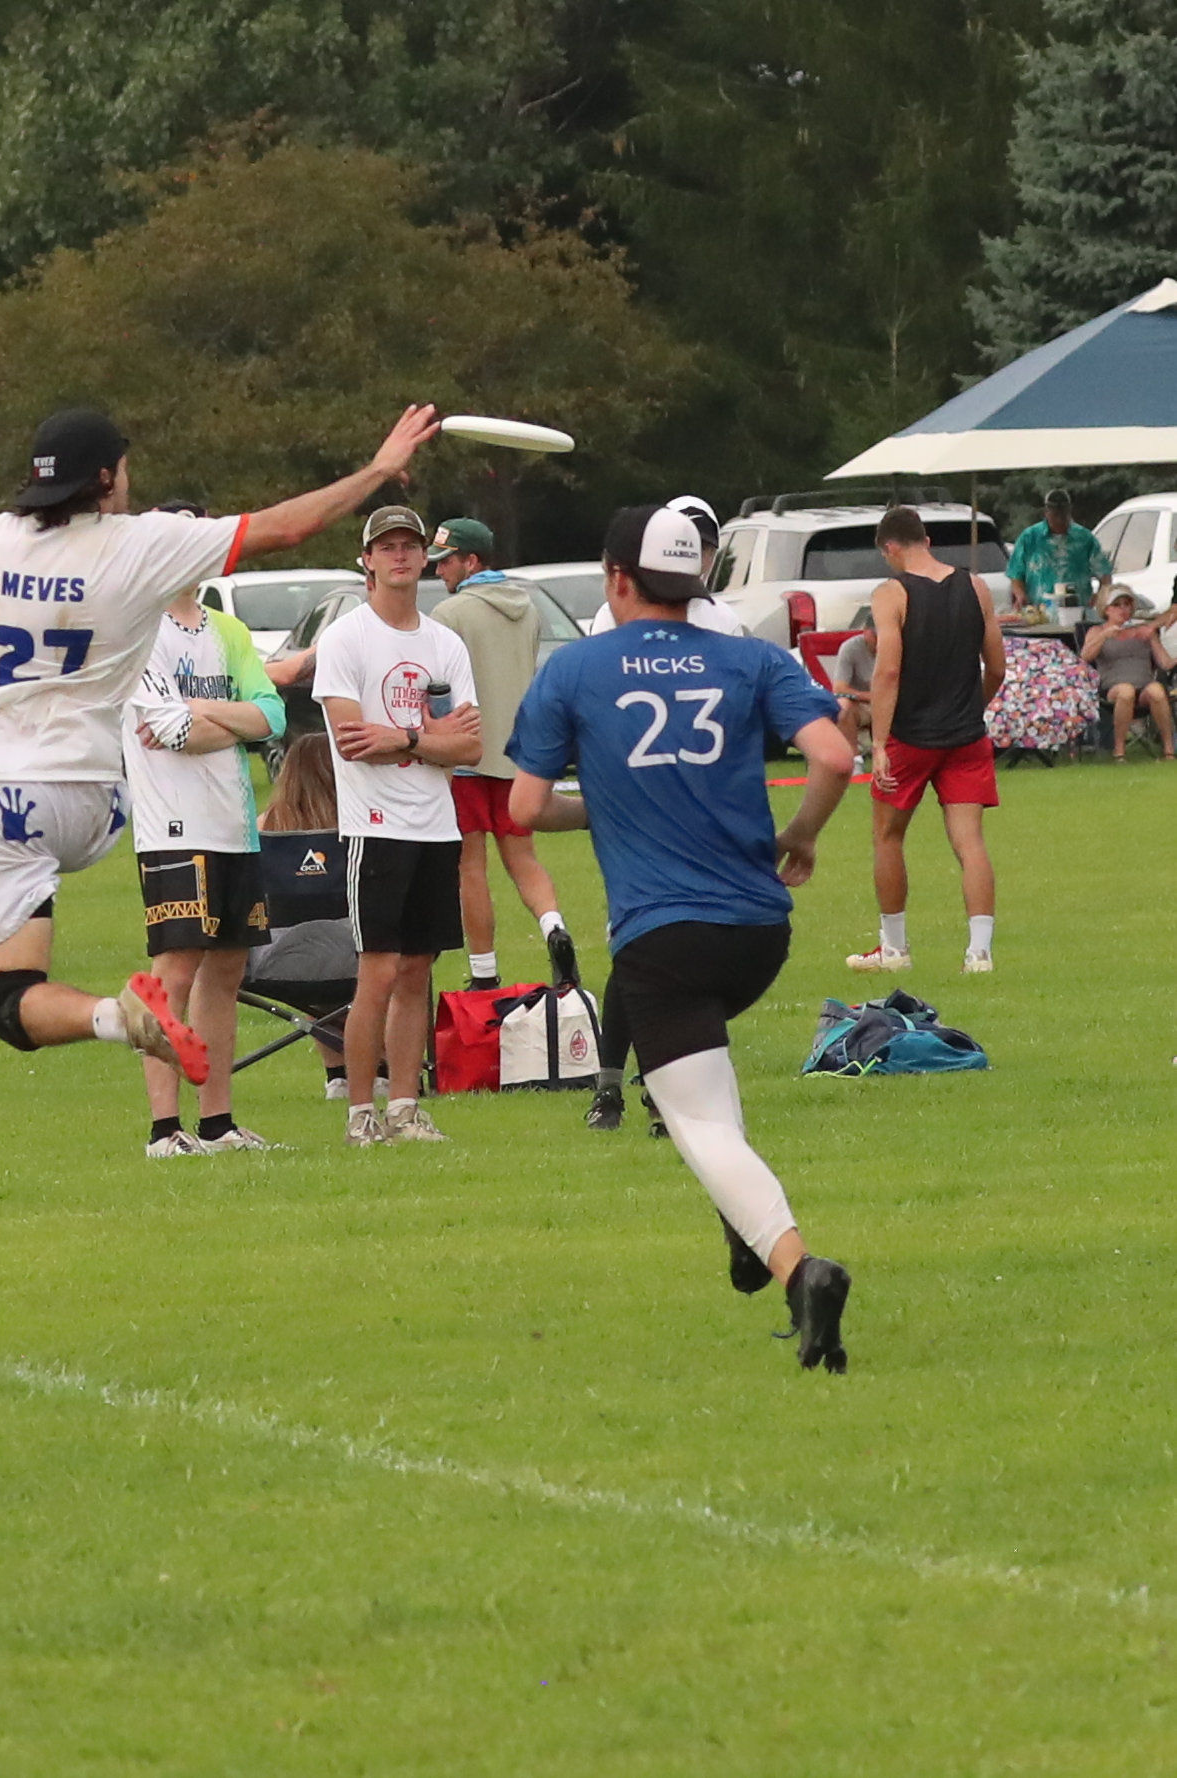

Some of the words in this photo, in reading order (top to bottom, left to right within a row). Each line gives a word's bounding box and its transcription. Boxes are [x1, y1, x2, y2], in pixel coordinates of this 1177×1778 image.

[2, 570, 85, 602] MEVES
[622, 655, 705, 675] HICKS
[615, 688, 724, 769] 23
